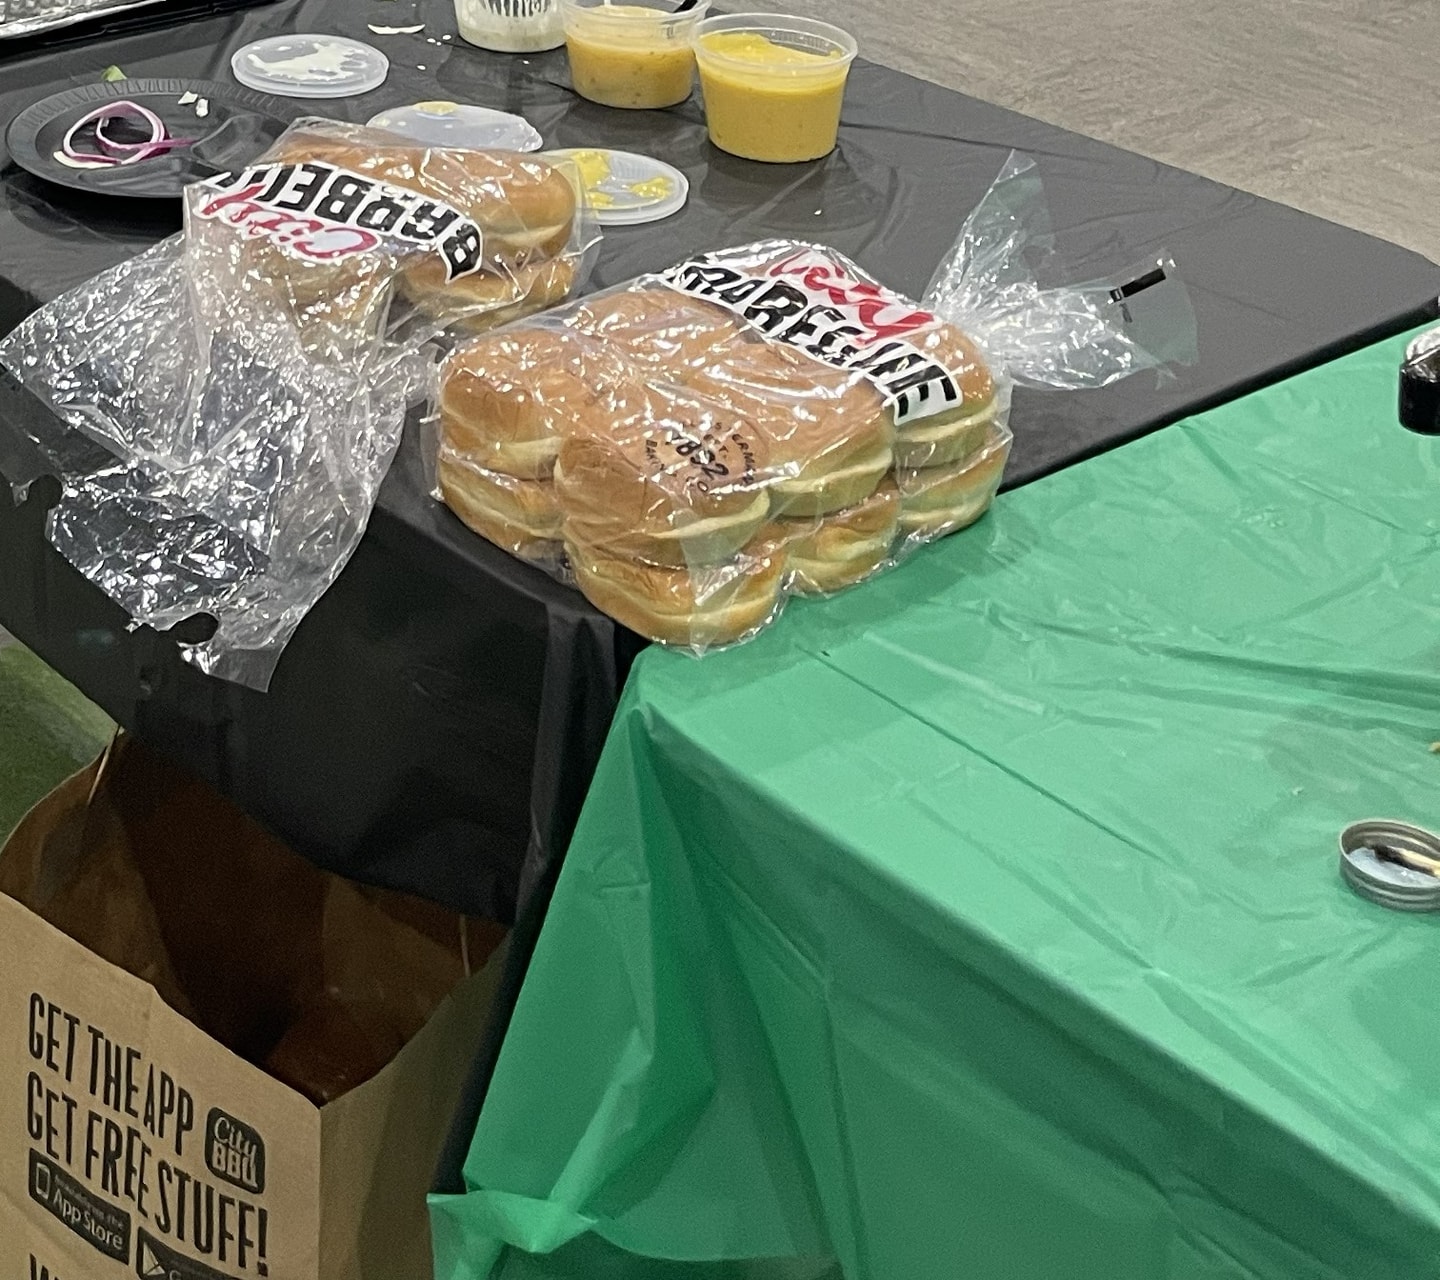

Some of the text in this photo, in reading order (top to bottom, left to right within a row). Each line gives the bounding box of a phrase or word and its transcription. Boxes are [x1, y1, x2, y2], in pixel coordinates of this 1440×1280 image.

[29, 992, 194, 1157] GET THE APP
[27, 1071, 78, 1166] GET
[85, 1109, 152, 1219] FREE
[155, 1159, 269, 1278] STUFF!
[214, 1116, 257, 1158] City
[53, 1189, 82, 1225] App
[83, 1210, 123, 1251] Store
